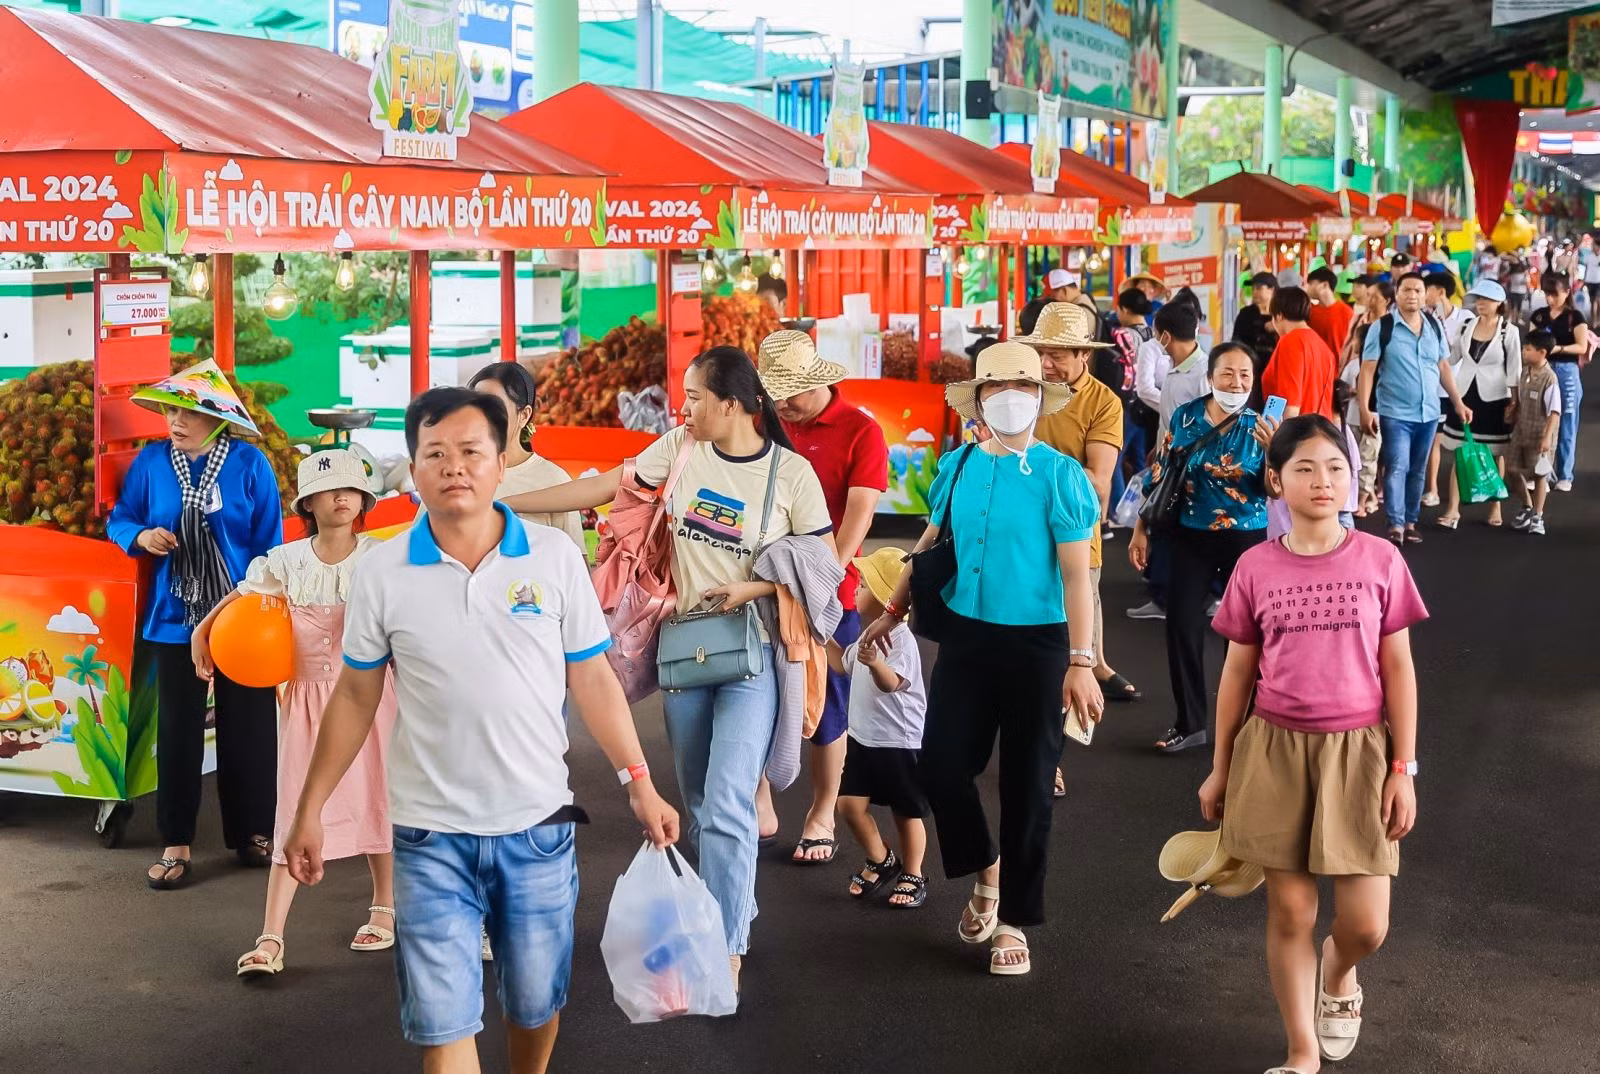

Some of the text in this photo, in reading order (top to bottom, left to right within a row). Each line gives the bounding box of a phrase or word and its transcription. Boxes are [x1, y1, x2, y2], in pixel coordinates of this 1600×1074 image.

[390, 44, 457, 110] FARM
[393, 137, 449, 159] FESTIVAL
[42, 175, 119, 202] 2024
[186, 170, 593, 238] LỄ HỘI TRÁI CÂY NAM BỘ LẦN THỨ 20
[648, 200, 703, 218] 2024
[23, 214, 79, 242] THỨ
[82, 219, 115, 242] 20
[760, 202, 782, 241] HỘI
[784, 204, 810, 235] TRÁI
[811, 204, 834, 235] CÂY
[835, 212, 859, 235] NAM
[635, 225, 675, 244] THỨ
[677, 229, 700, 244] 20
[131, 307, 158, 319] 27.000
[318, 456, 331, 472] NY
